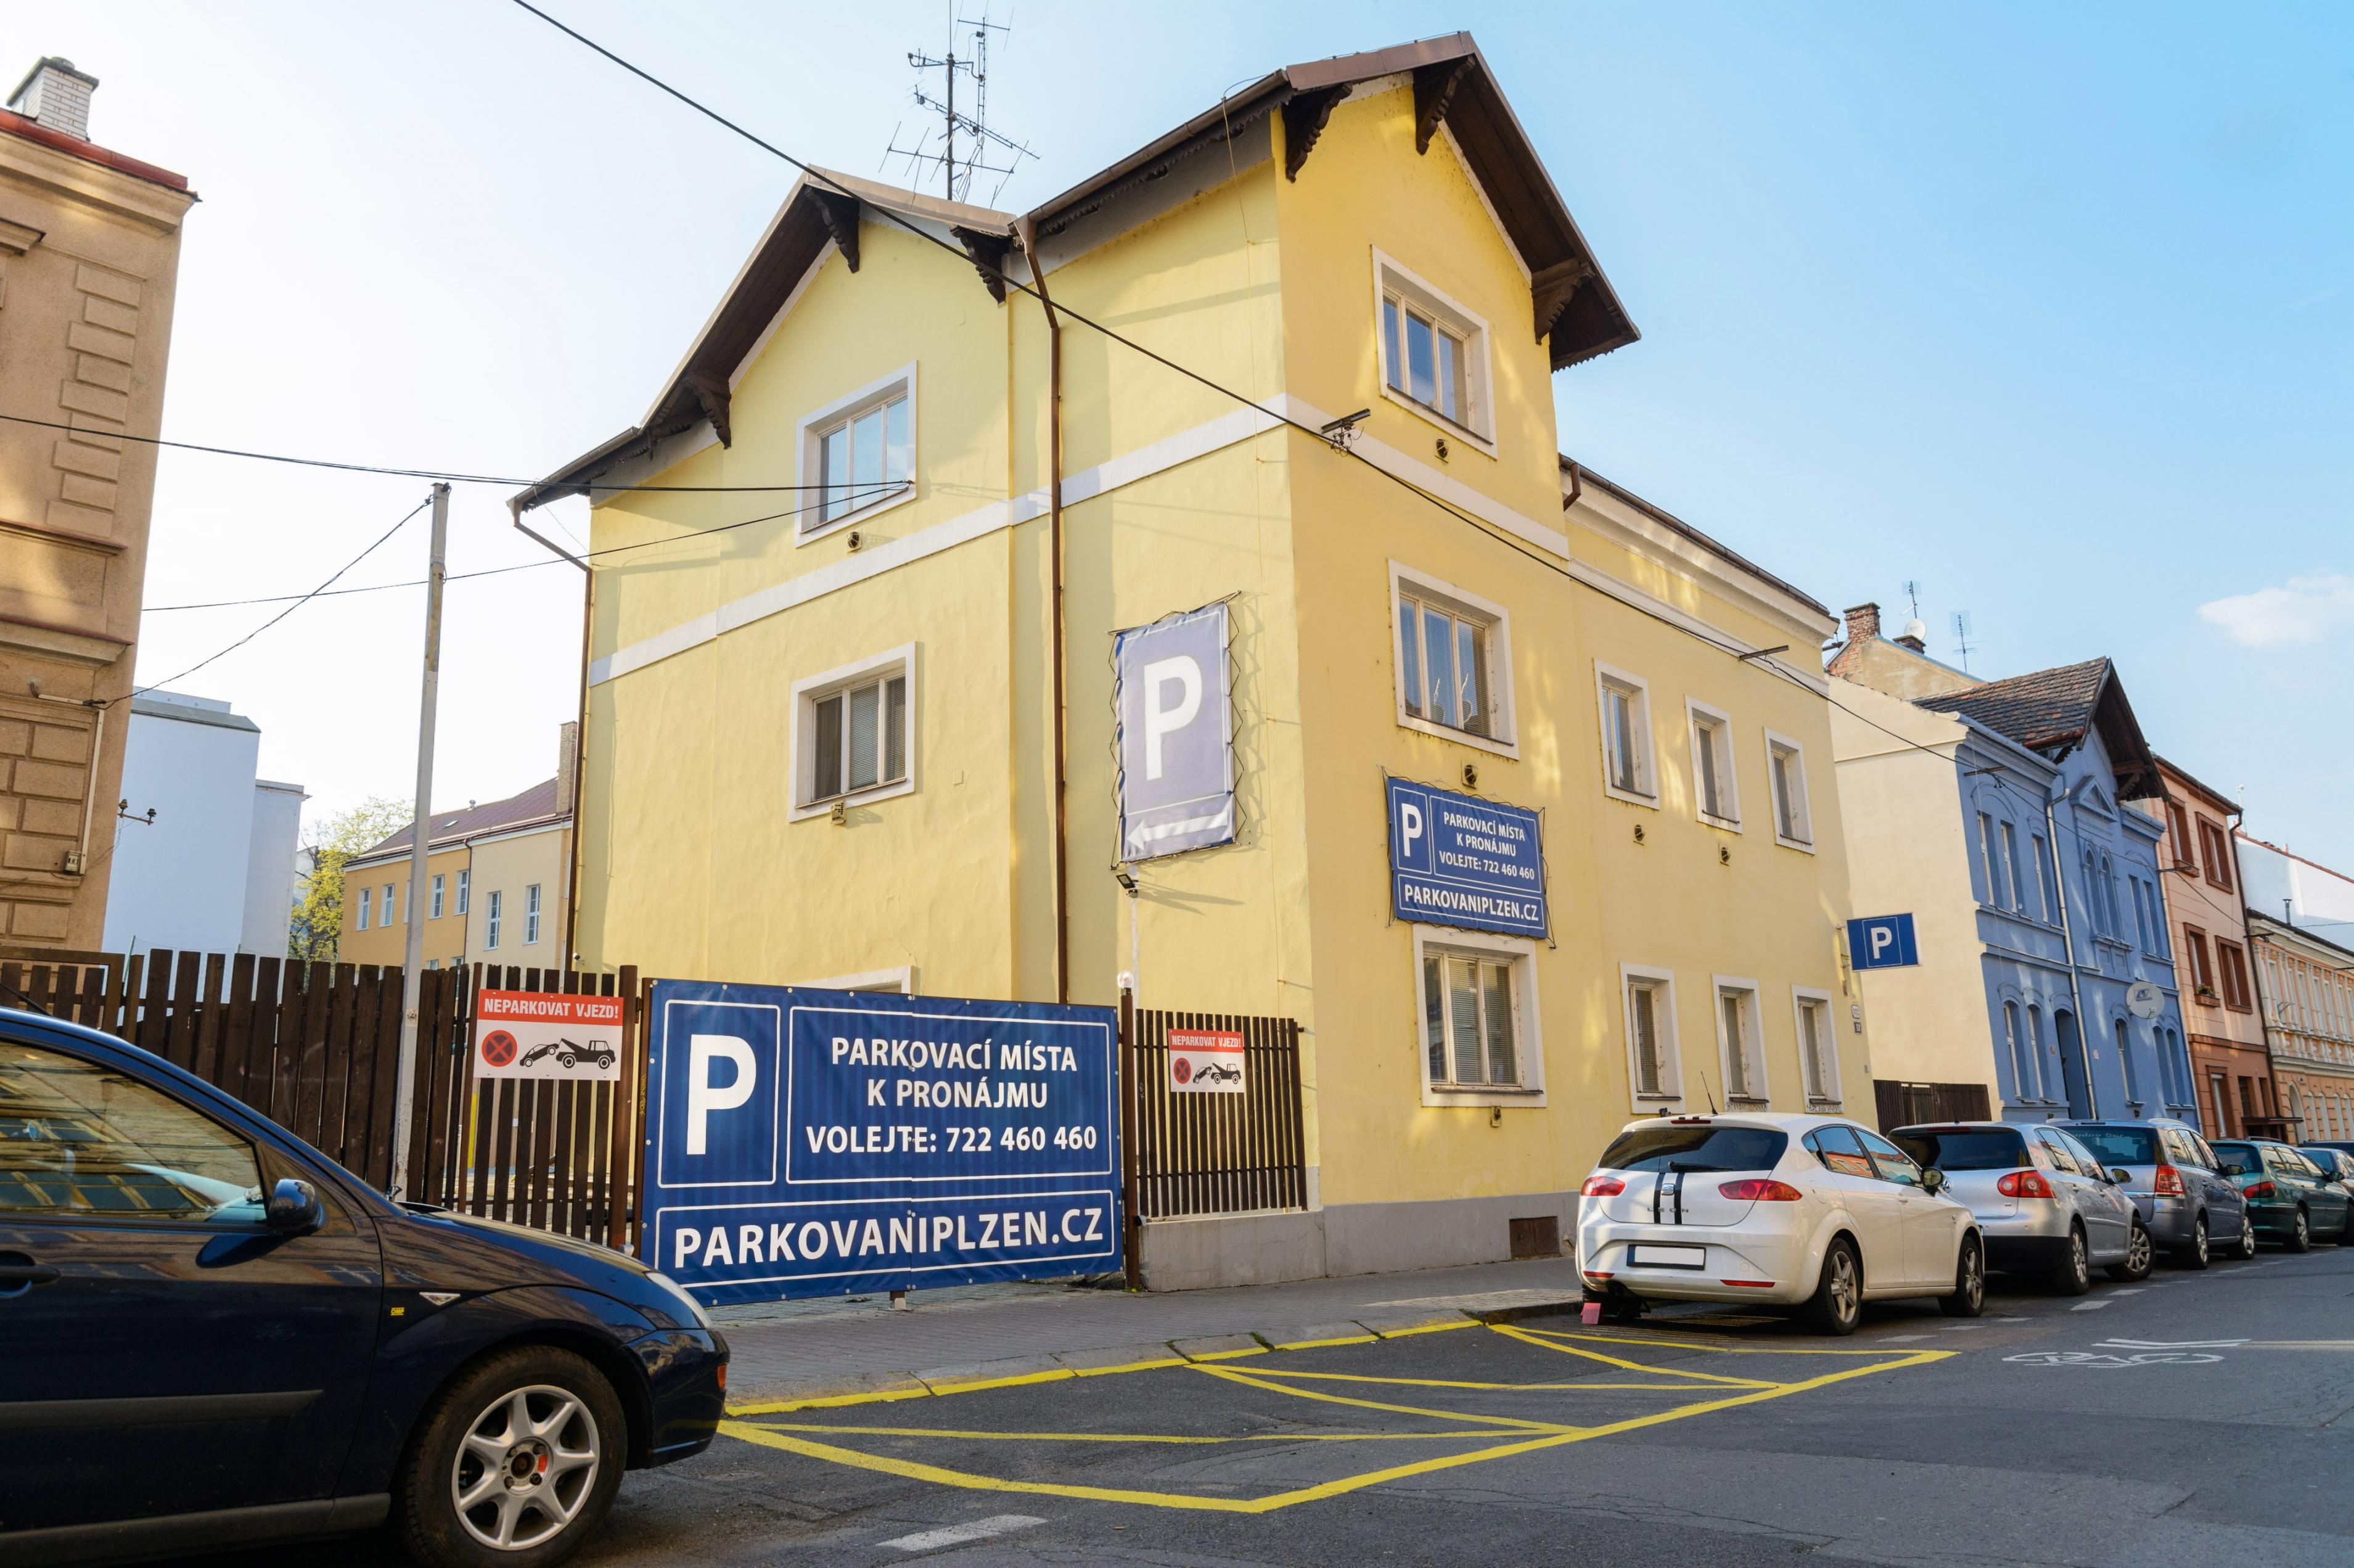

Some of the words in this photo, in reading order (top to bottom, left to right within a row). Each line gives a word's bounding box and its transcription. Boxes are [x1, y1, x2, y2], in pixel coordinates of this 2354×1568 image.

[1144, 655, 1202, 781] P
[1401, 803, 1422, 857] P
[1443, 811, 1496, 835] PARKOVACÍ
[1498, 823, 1525, 841] MÍSTA
[1456, 832, 1464, 847] K
[1466, 834, 1516, 857] PRONÁJMU
[1439, 850, 1482, 871] VOLEJTE:
[1483, 860, 1499, 874] 722
[1501, 863, 1517, 877] 460
[1519, 866, 1535, 880] 460
[1405, 884, 1540, 921] PARKOVANIPLZEN.CZ
[1871, 927, 1892, 959] P
[484, 998, 571, 1017] NEPARKOVAT
[576, 1003, 618, 1019] VJEZD!
[831, 1037, 992, 1070] PARKOVACÍ
[999, 1040, 1078, 1072] MÍSTA
[1171, 1035, 1216, 1046] NEPARKOVAT
[1218, 1037, 1241, 1048] VJEZD!
[686, 1034, 757, 1155] P
[867, 1079, 886, 1107] K
[896, 1076, 1048, 1108] PRONÁJMU
[805, 1125, 937, 1153] VOLEJTE:
[945, 1127, 992, 1152] 722
[999, 1127, 1046, 1151] 460
[1053, 1126, 1097, 1150] 460
[675, 1207, 1104, 1268] PARKOVANIPLZEN.CZ
